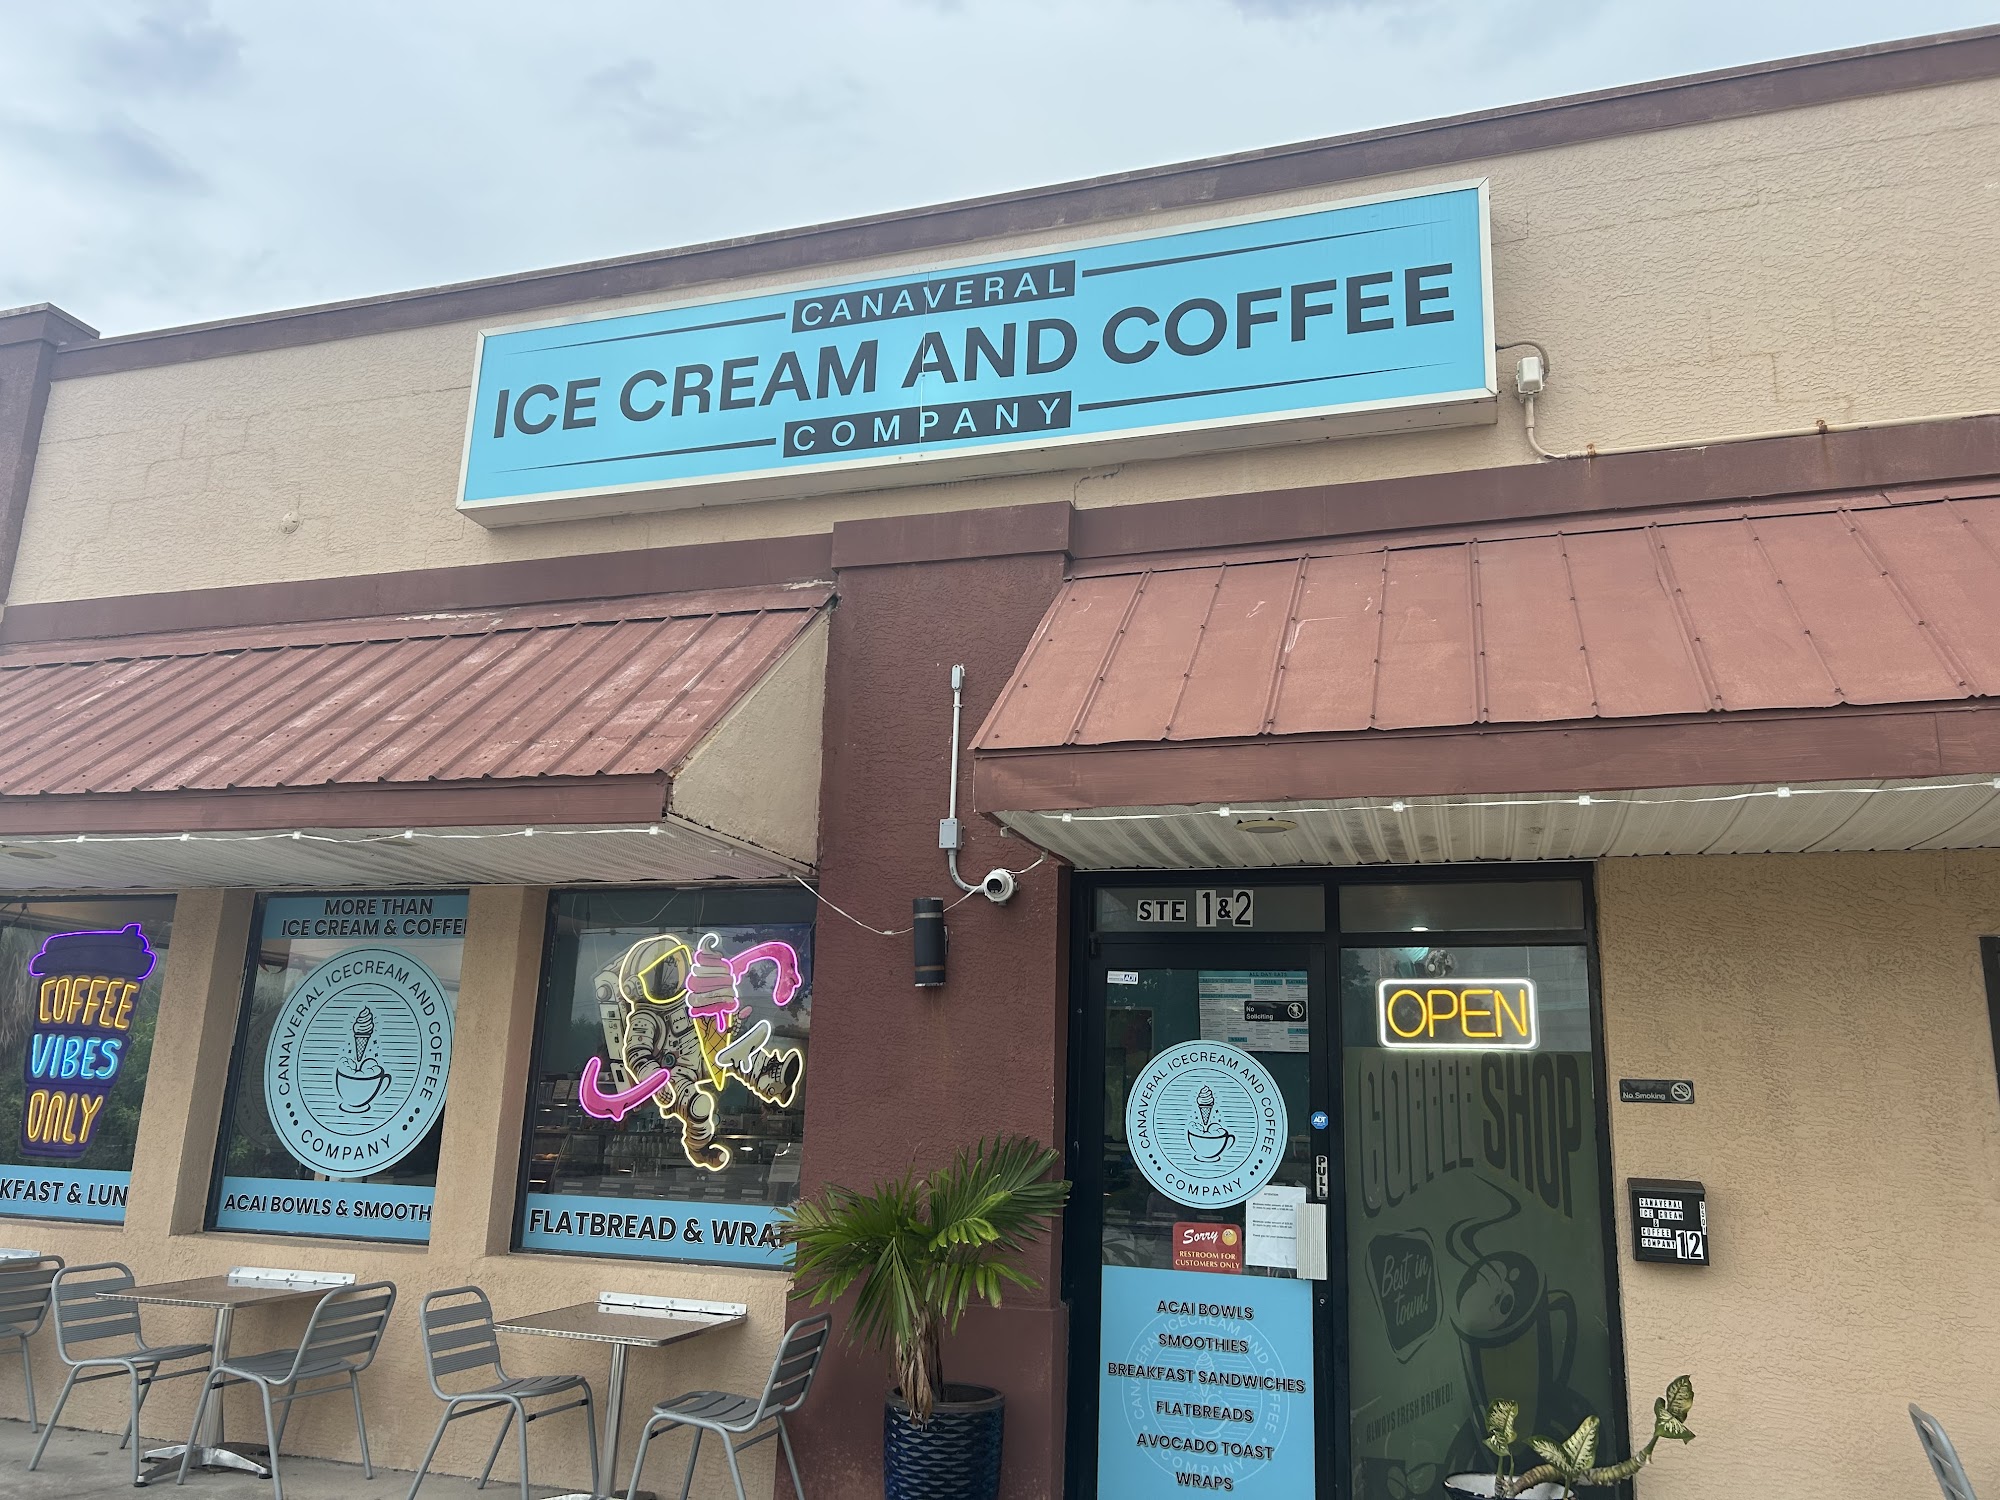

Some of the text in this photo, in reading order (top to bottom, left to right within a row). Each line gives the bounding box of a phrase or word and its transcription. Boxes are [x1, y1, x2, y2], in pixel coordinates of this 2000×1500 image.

[800, 268, 1067, 327] CANAVERAL
[493, 262, 1455, 439] ICE CREAM AND COFFEE
[792, 397, 1062, 452] COMPANY
[323, 897, 433, 916] MORE THAN
[1138, 890, 1252, 926] STE 1&2
[281, 919, 311, 936] ICE
[314, 918, 380, 936] CREAM
[383, 918, 397, 936] &
[325, 960, 410, 987] ICECREAM
[38, 975, 140, 1030] COFFEE
[408, 980, 436, 1016] AND
[1246, 1005, 1255, 1013] No
[1246, 1013, 1274, 1022] Soliciting
[1387, 989, 1528, 1038] OPEN
[278, 987, 324, 1096] CANAVERAL
[31, 1033, 123, 1080] VIBES
[419, 1020, 443, 1101] COFFEE
[1137, 1051, 1276, 1155] CANAVERAL ICECREAM AND COFFEE
[1635, 1092, 1666, 1100] Smoking
[26, 1090, 103, 1144] ONLY
[301, 1128, 392, 1161] COMPANY
[1480, 1052, 1582, 1219] SHOP
[1165, 1173, 1242, 1196] COMPANY
[1317, 1156, 1327, 1197] PULL
[66, 1182, 82, 1204] &
[1639, 1198, 1682, 1209] CANAVERAL
[223, 1193, 432, 1221] ACAI BOWLS & SMOOTH
[1640, 1209, 1653, 1217] ICE
[529, 1208, 785, 1250] FLATBREAD & WRA
[1182, 1228, 1219, 1245] Sorry
[1642, 1227, 1671, 1237] COFFEE
[1179, 1251, 1236, 1261] RESTROOM FOR
[1643, 1239, 1675, 1249] COMPANY
[1677, 1231, 1702, 1258] 12
[1175, 1258, 1240, 1269] CUSTOMERS ONLY
[1382, 1252, 1429, 1298] Best in
[1156, 1300, 1254, 1320] ACAI BOWLS
[1158, 1333, 1249, 1353] SMOOTHIES
[1107, 1362, 1307, 1393] BREAKFAST SANDWICHES
[1156, 1401, 1254, 1422] FLATBREADS
[1136, 1433, 1275, 1460] AVOCADO TOAST
[1175, 1471, 1234, 1491] WRAPS
